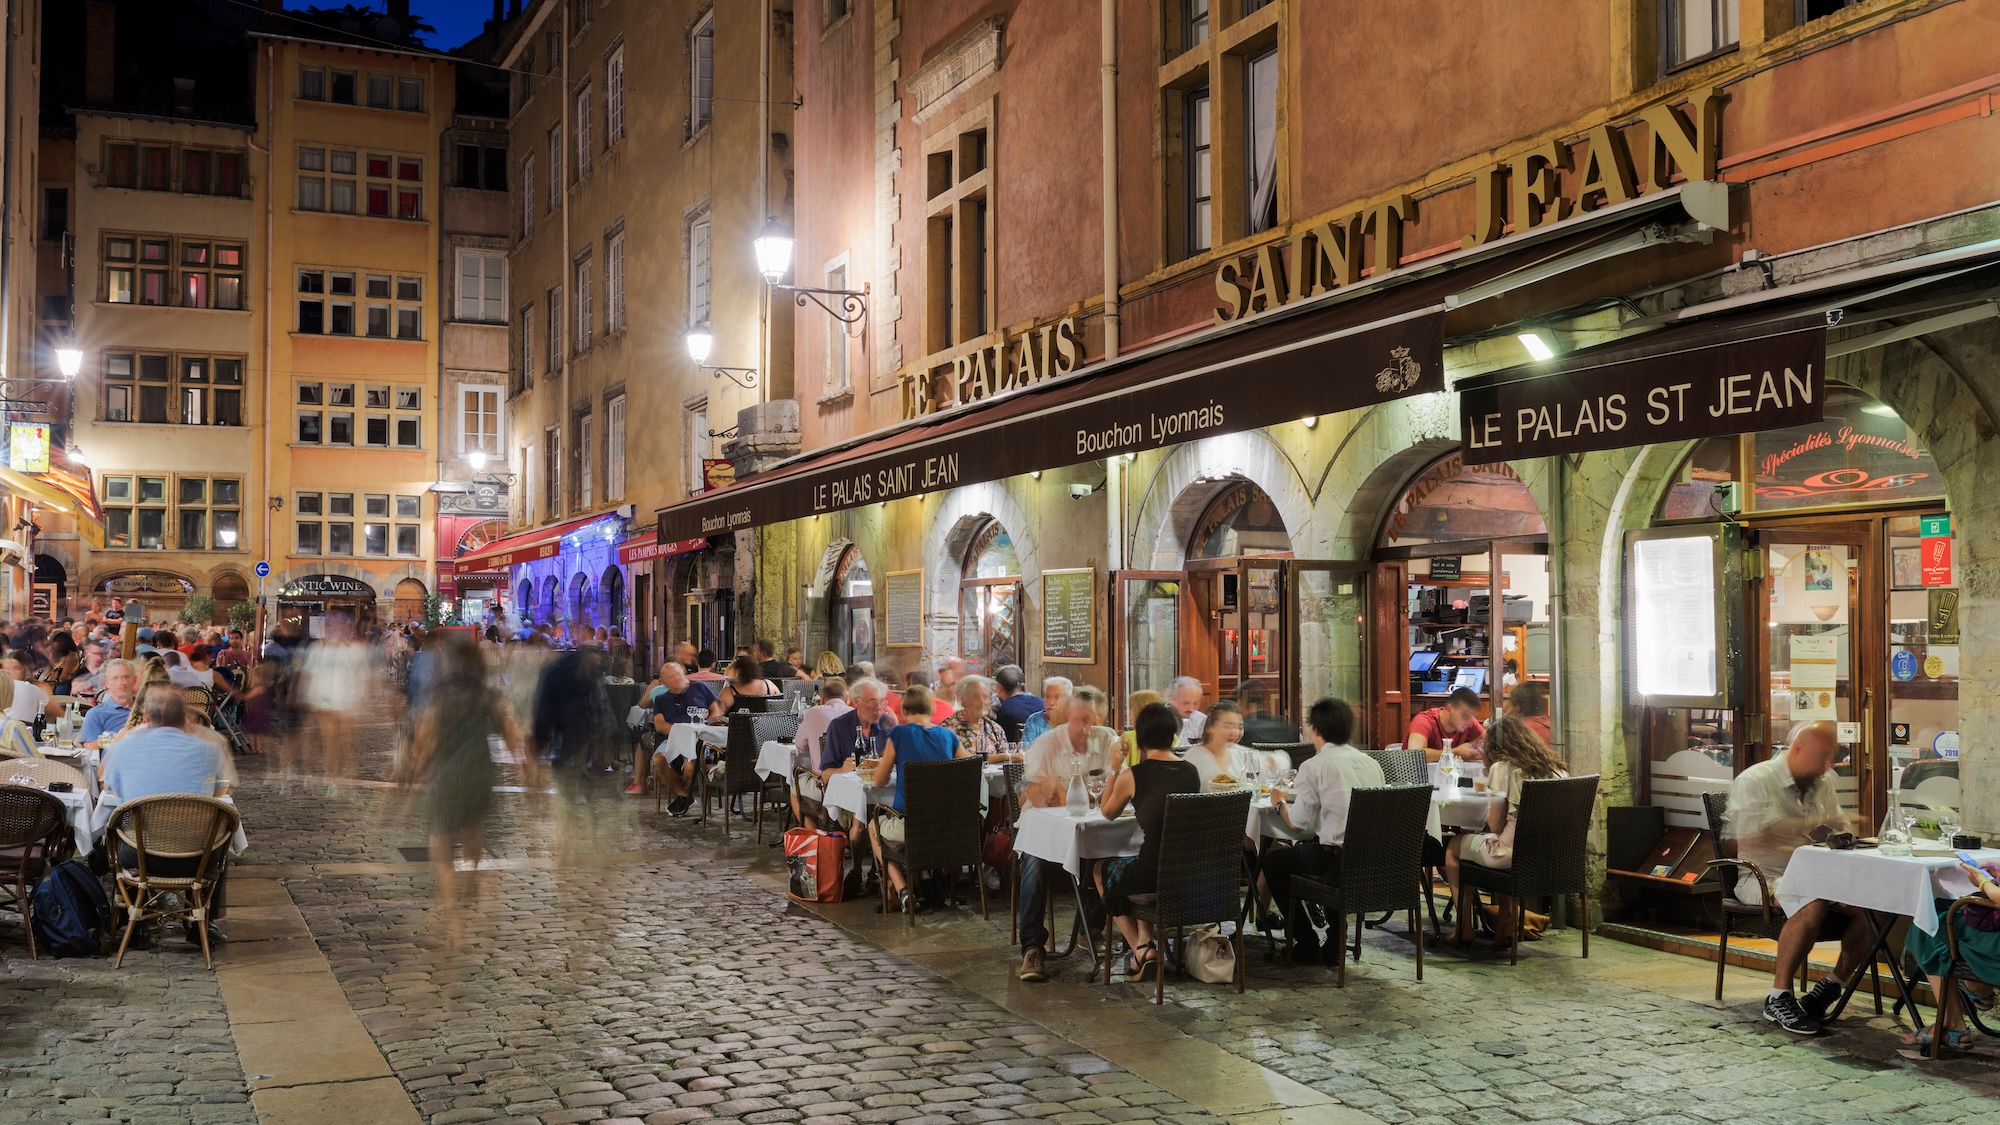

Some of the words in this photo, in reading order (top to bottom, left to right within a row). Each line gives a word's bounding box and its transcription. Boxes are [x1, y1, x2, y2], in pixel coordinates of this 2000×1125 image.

[1213, 195, 1416, 326] SAINT
[1460, 87, 1728, 250] JEAN
[897, 367, 936, 422] LE
[951, 316, 1080, 409] PALAIS
[1076, 422, 1142, 455] Bouchon
[1150, 399, 1225, 445] Lyonnais
[1468, 411, 1503, 449] LE
[1516, 393, 1628, 443] PALAIS
[1645, 382, 1692, 426] ST
[1707, 362, 1814, 419] JEAN
[1761, 431, 1832, 477] Spécialités
[1835, 426, 1920, 460] Lyonnaises
[813, 484, 827, 511] LE
[831, 473, 872, 508] PALAIS
[877, 462, 916, 498] SAINT
[921, 452, 960, 489] JEAN
[1405, 456, 1462, 513] PALAIS
[701, 515, 725, 532] Bouchon
[726, 506, 752, 530] Lyonnais
[628, 547, 637, 561] LES
[290, 580, 327, 591] ANTIC
[330, 580, 362, 591] WINE
[1944, 749, 1959, 757] 2018
